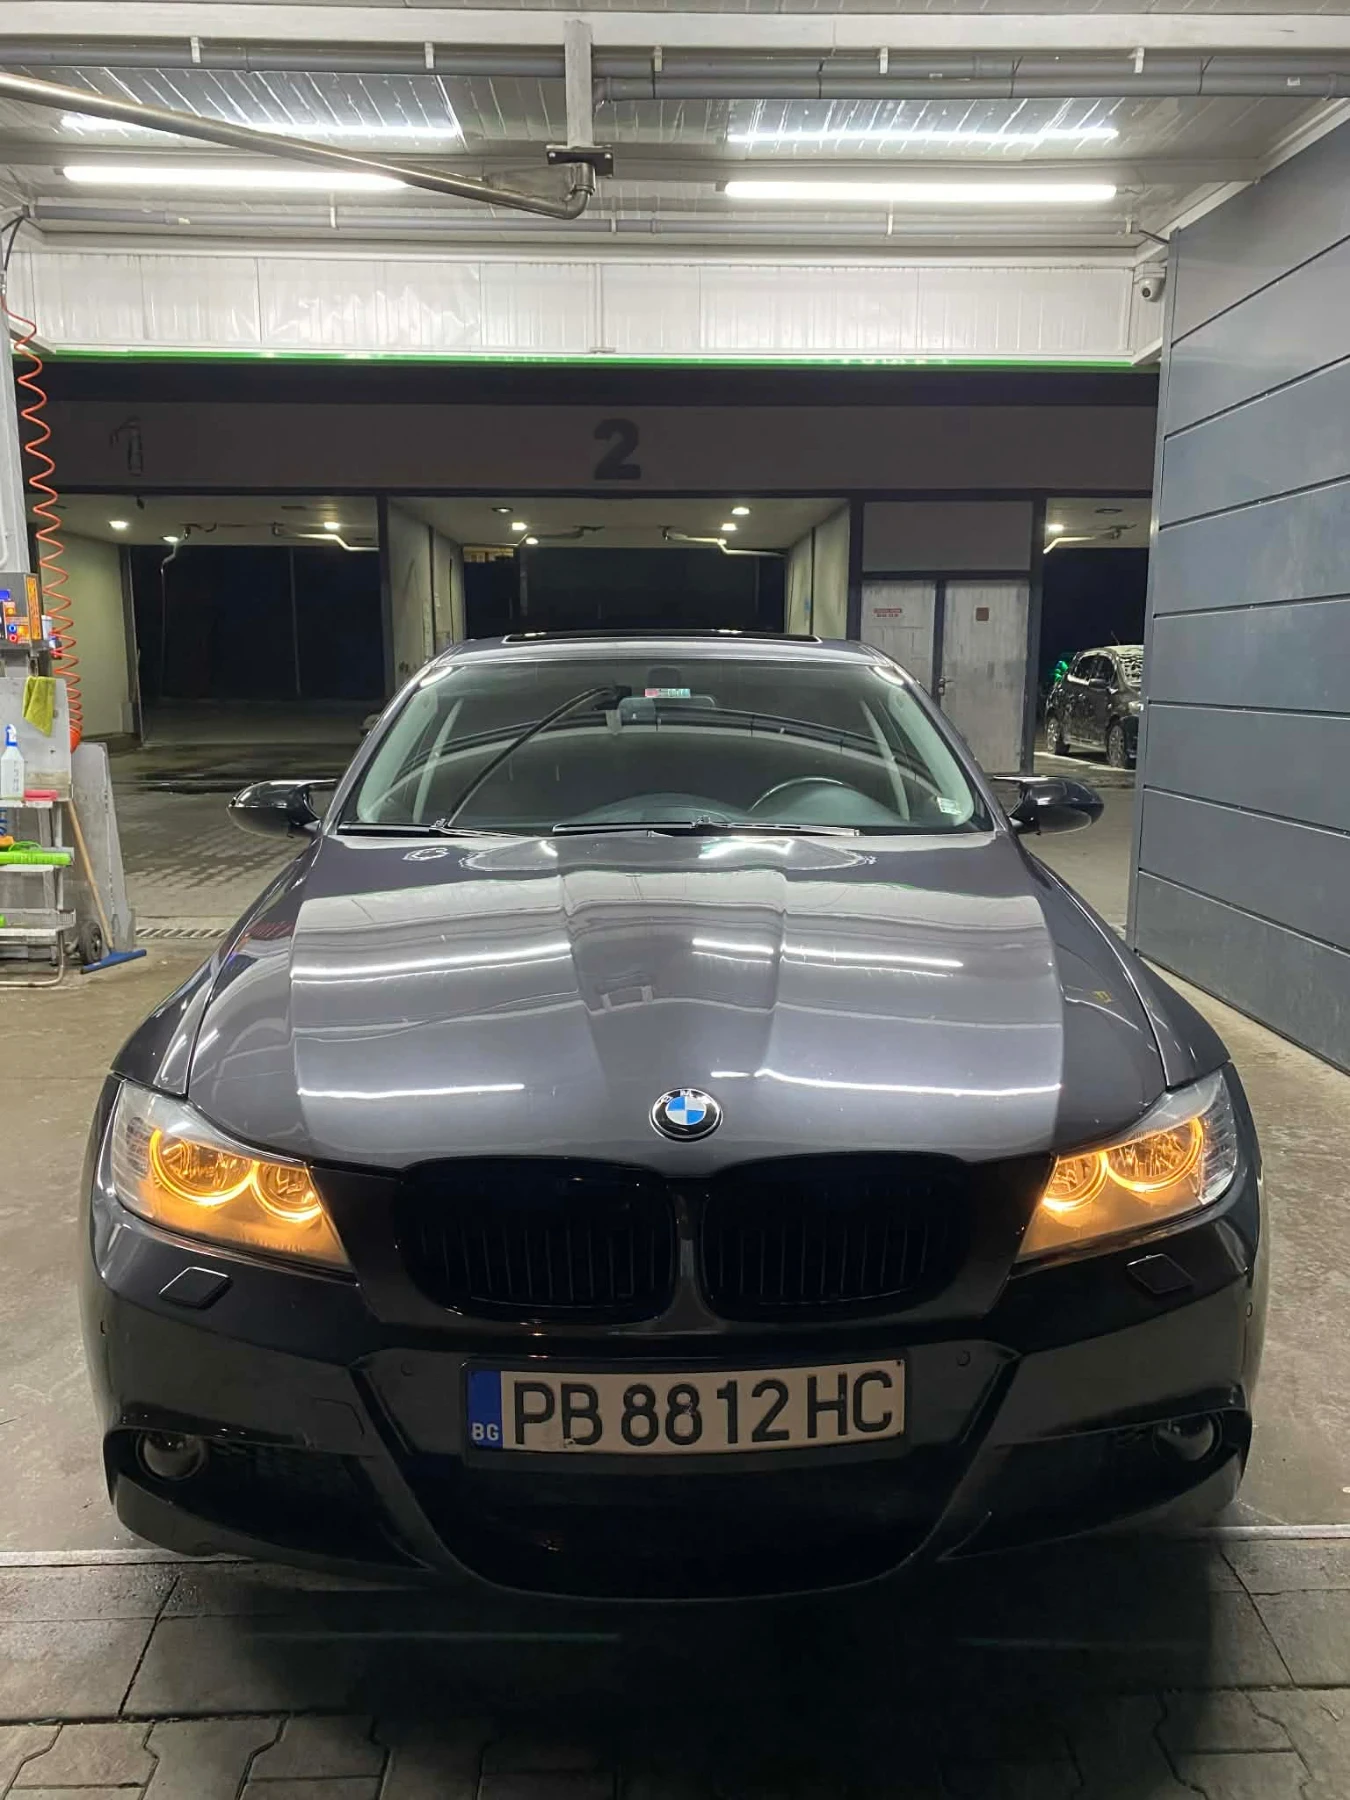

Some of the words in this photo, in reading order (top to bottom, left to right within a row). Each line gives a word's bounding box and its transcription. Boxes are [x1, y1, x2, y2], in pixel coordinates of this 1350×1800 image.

[594, 419, 641, 480] 2
[471, 1422, 500, 1441] BG
[514, 1380, 602, 1446] PB
[621, 1379, 790, 1446] 8812
[807, 1370, 893, 1438] HC
